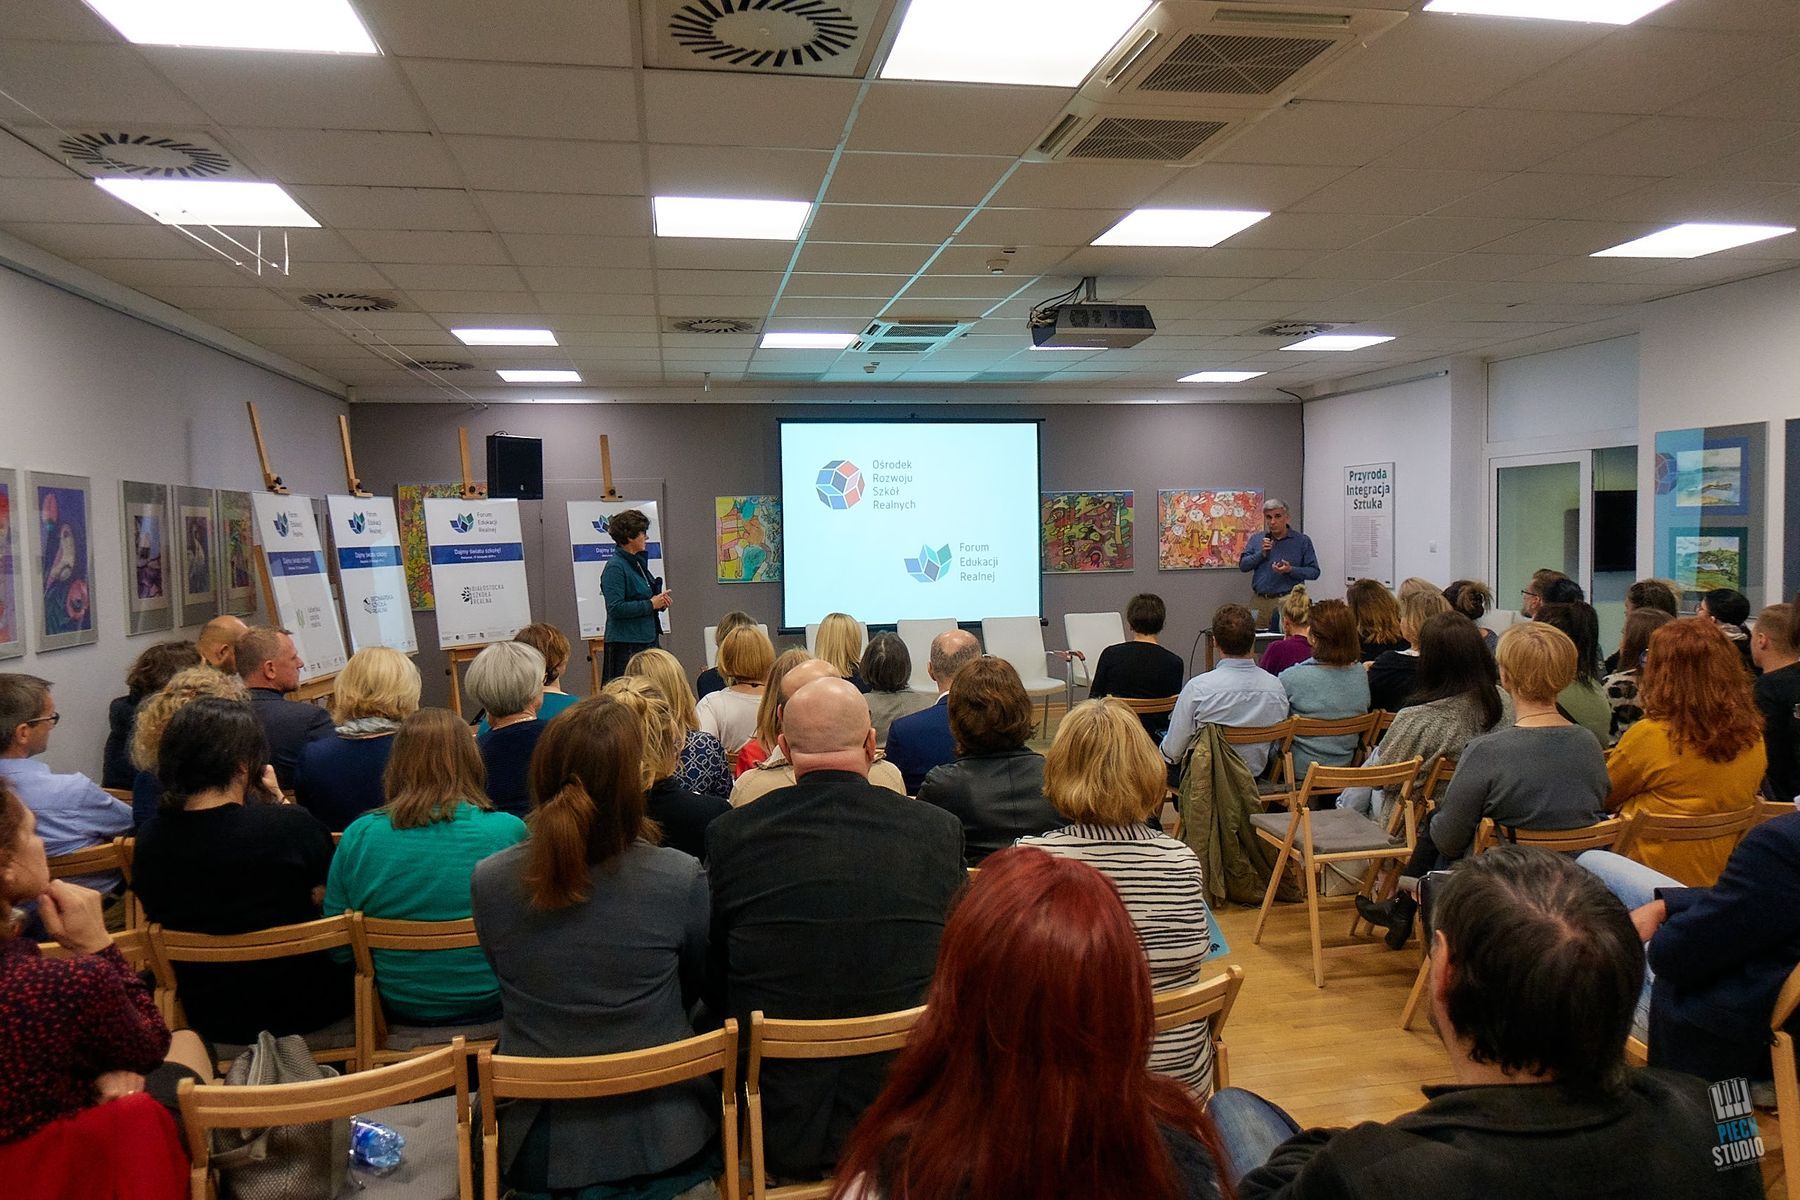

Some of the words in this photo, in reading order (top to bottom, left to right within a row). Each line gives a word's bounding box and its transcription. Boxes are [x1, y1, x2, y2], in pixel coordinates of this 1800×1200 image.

[872, 459, 912, 470] Ośrodek
[872, 473, 913, 484] Rozwoju
[1349, 468, 1387, 484] Przyroda
[872, 486, 900, 496] Szkół
[1346, 482, 1390, 498] Integracja
[873, 500, 916, 511] Realnych
[1353, 497, 1383, 510] Sztuka
[959, 543, 990, 552] Forum
[959, 557, 999, 568] Edukacji
[960, 571, 996, 583] Realnej
